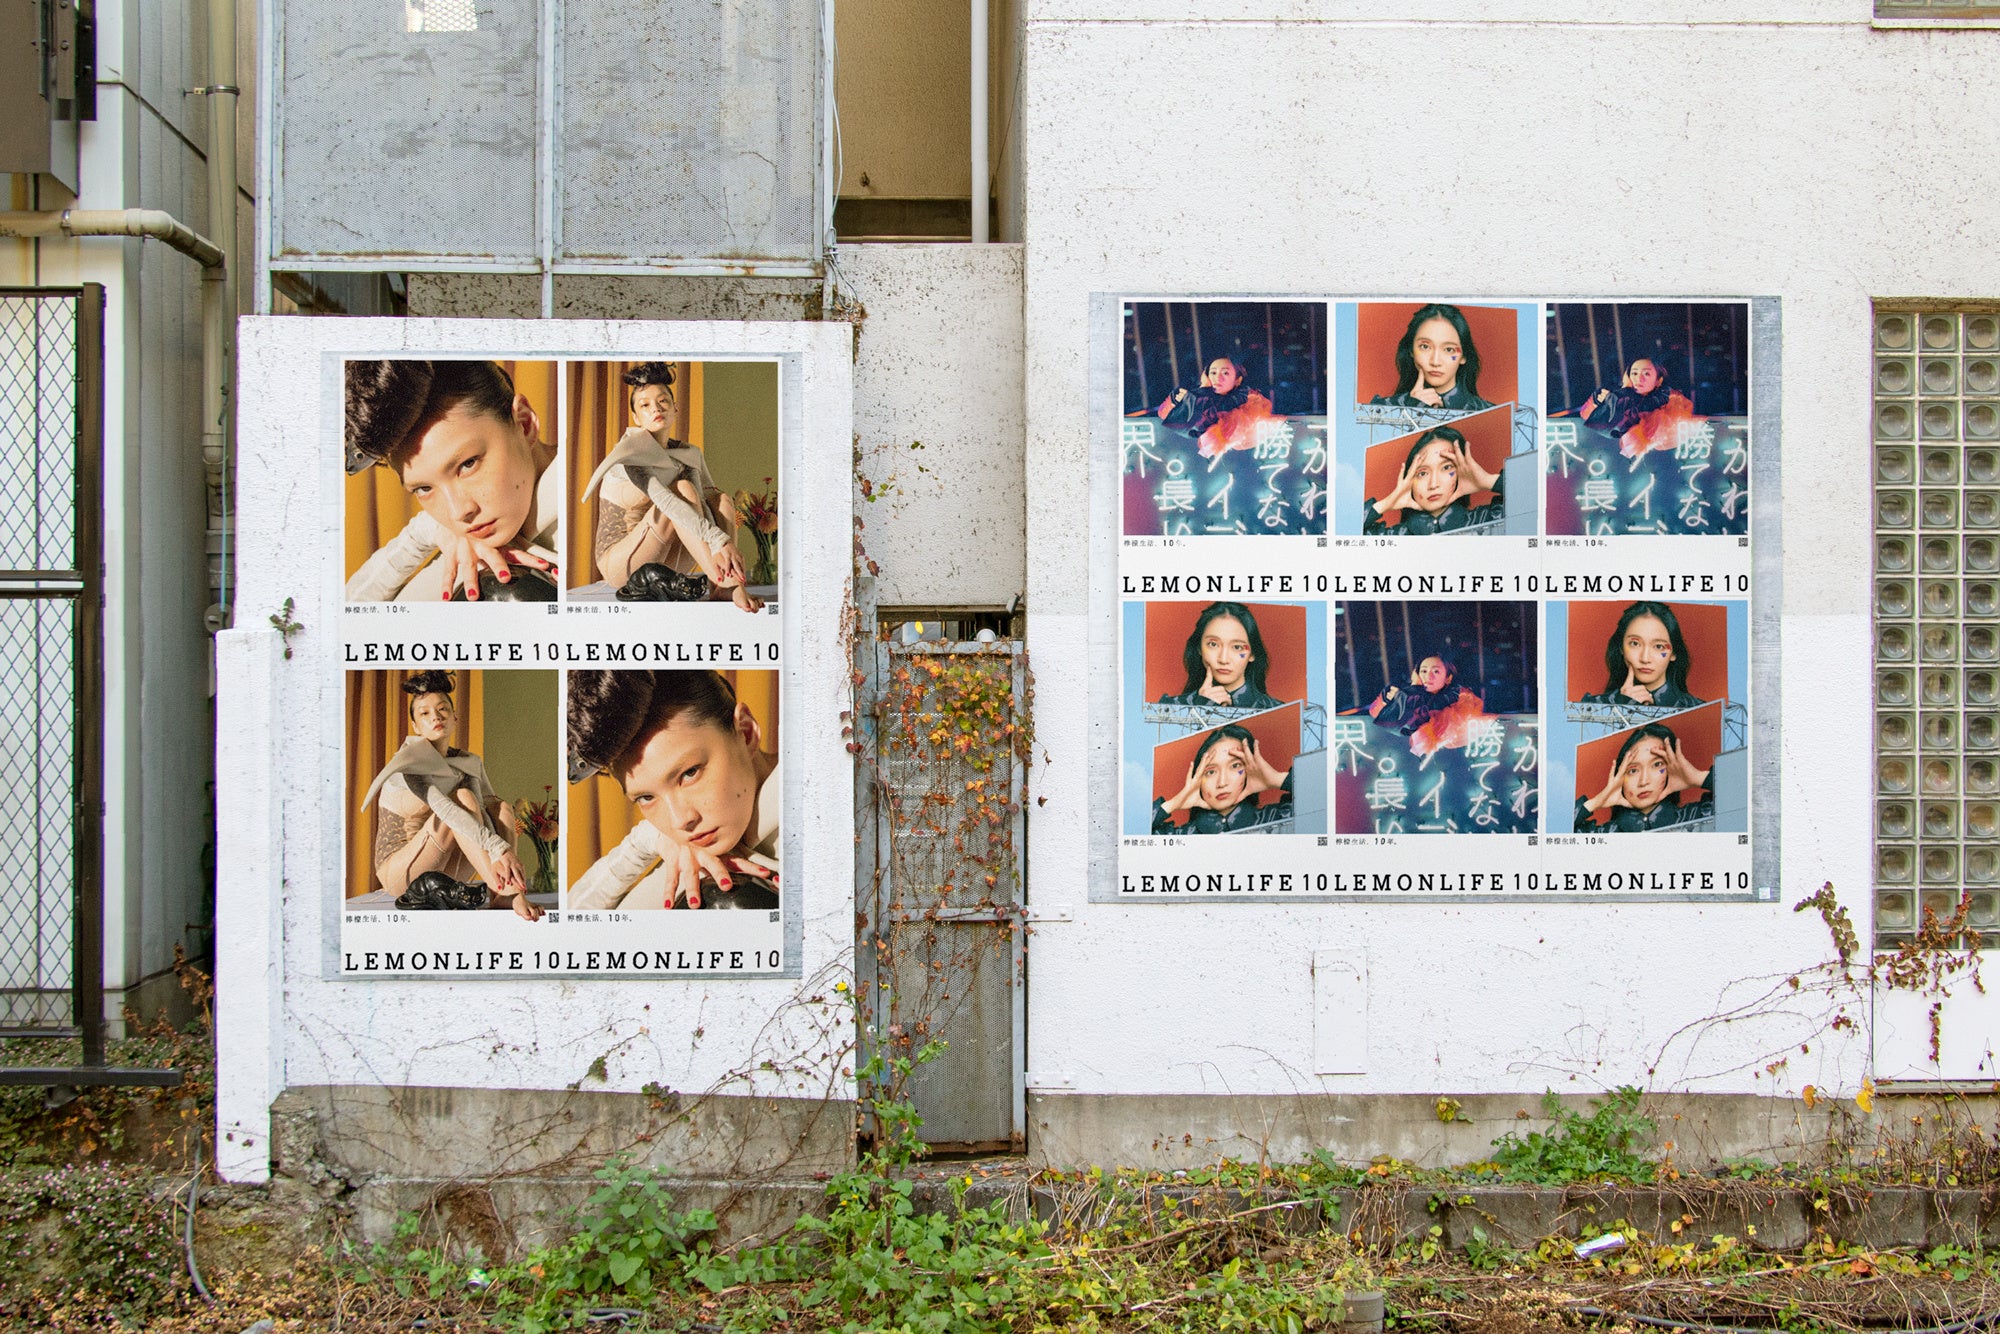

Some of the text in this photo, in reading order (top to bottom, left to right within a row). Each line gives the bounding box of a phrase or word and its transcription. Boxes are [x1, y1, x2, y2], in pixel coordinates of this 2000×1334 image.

[1252, 420, 1294, 535] 勝てな
[1674, 420, 1716, 535] 勝てな
[1123, 575, 1327, 593] LEMONLIFE 10
[1335, 576, 1537, 593] LEMONLIFE 10
[1546, 575, 1748, 592] LEMONLIFE 10
[345, 643, 558, 661] LEMONLIFE 10
[566, 643, 778, 661] LEMONLIFE 10
[1465, 718, 1505, 834] 勝てな
[1123, 874, 1327, 892] LEMONLIFE 10
[1335, 874, 1538, 891] LEMONLIFE 10
[1546, 872, 1748, 890] LEMONLIFE 10
[345, 952, 559, 970] LEMONLIFE 10
[567, 950, 779, 969] LEMONLIFE 10
